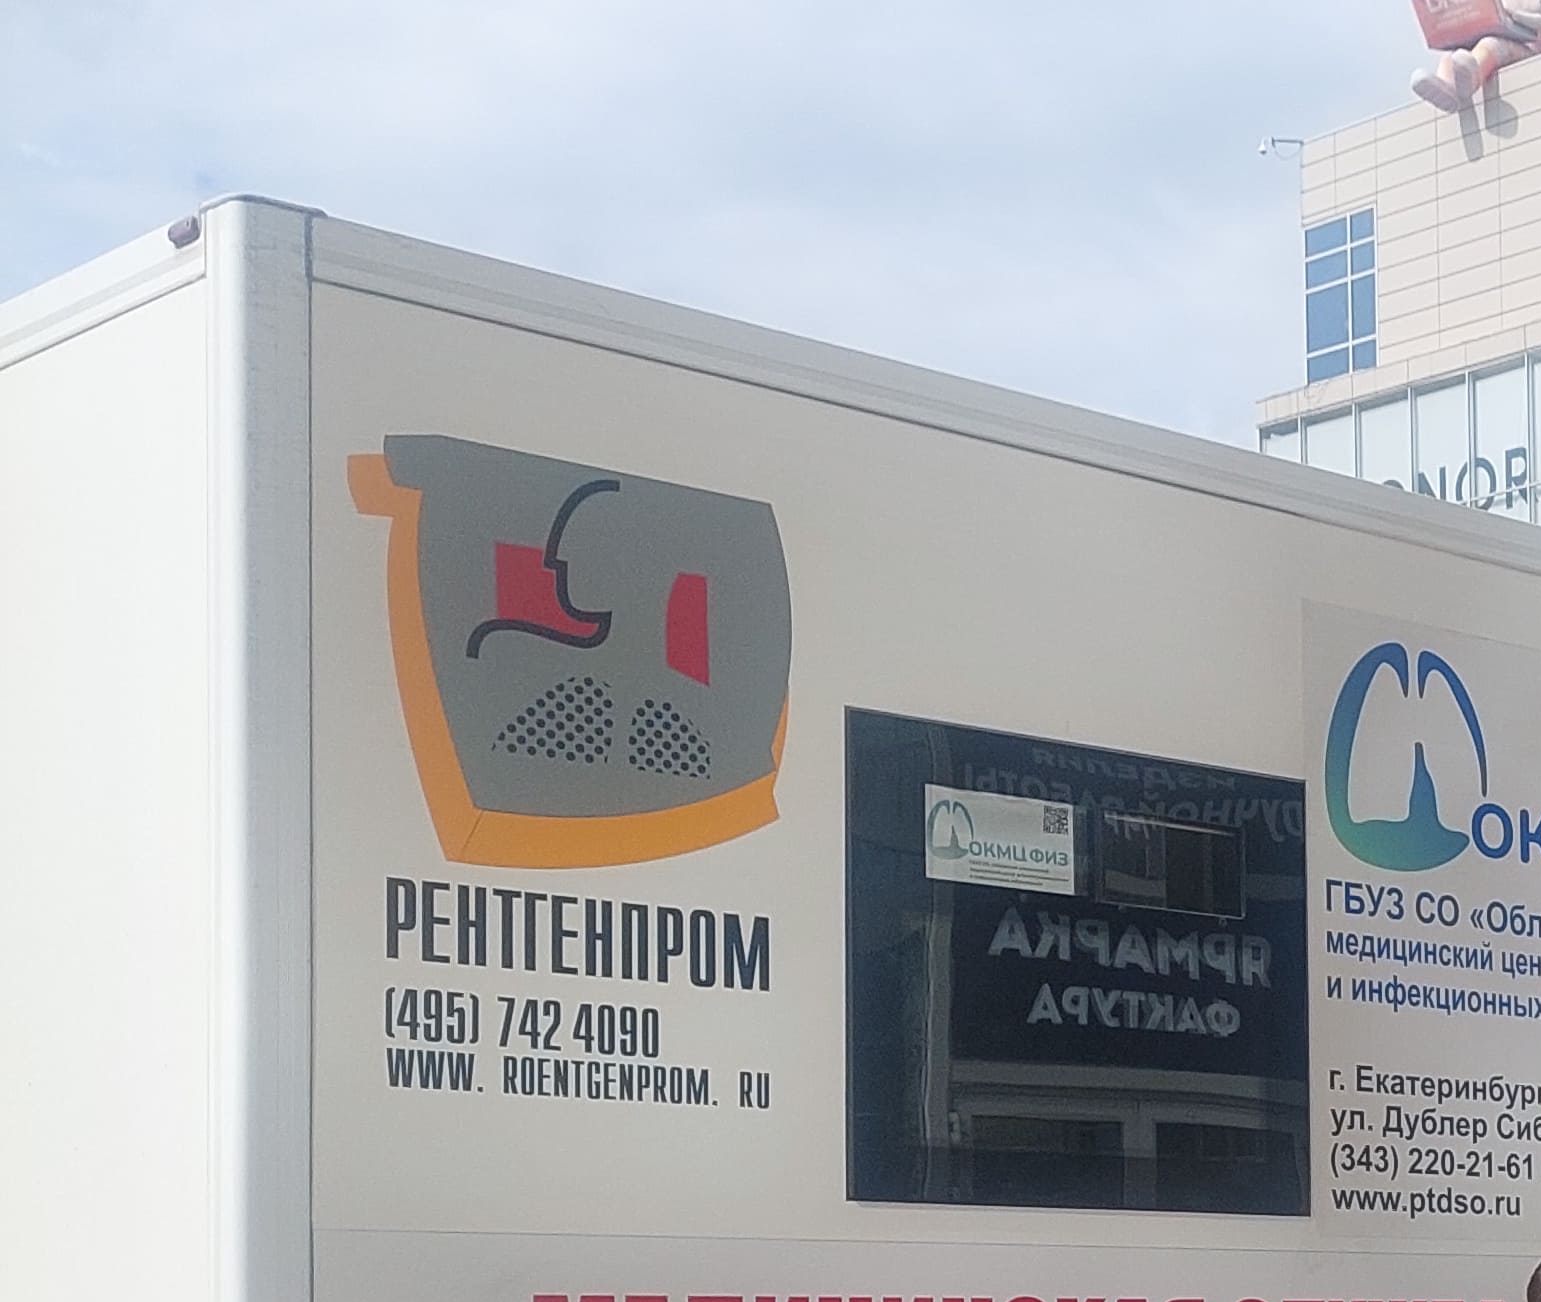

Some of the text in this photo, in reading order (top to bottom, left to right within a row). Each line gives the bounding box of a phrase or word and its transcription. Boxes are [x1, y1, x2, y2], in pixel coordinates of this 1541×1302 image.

[969, 841, 1069, 867] ОКМЦФИЗ
[1326, 879, 1405, 921] ГБУЗ
[1415, 890, 1459, 927] СО
[385, 876, 771, 992] РЕНТГЕНПРОМ
[1327, 931, 1493, 972] медицинский
[1327, 976, 1343, 999] и
[384, 986, 660, 1059] (495) 742 4090
[738, 1071, 770, 1110] RU
[1329, 1069, 1345, 1091] г.
[1331, 1107, 1373, 1137] ул.
[1382, 1106, 1488, 1144] Дублер
[1330, 1144, 1400, 1179] (343)
[1408, 1148, 1534, 1181] 220-21-61
[1332, 1187, 1522, 1219] www.ptdso.ru
